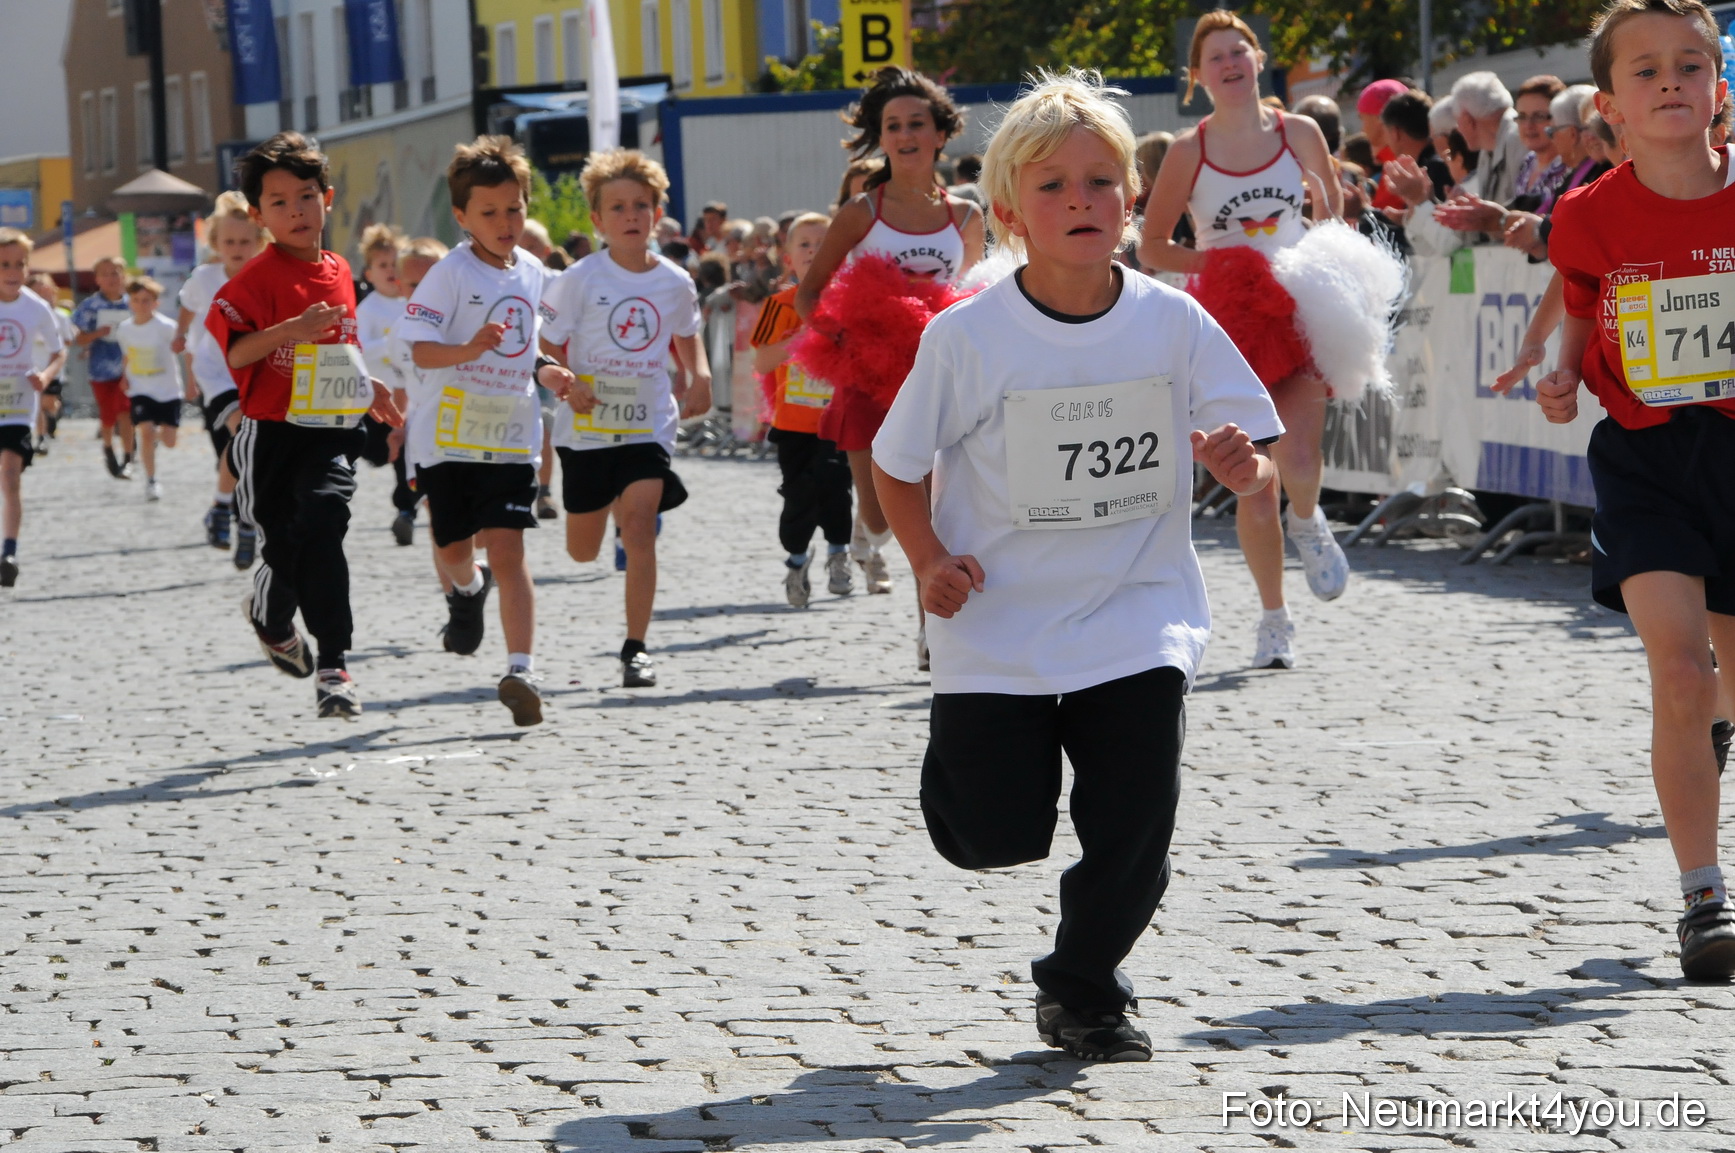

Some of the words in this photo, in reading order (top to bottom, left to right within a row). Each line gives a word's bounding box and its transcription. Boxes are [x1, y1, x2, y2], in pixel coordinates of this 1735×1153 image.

[861, 13, 893, 62] B
[1691, 249, 1709, 260] 11.
[1661, 289, 1720, 312] Jonas
[1627, 330, 1645, 348] K4
[320, 351, 350, 366] Jonas
[319, 376, 368, 399] 7005
[597, 381, 637, 395] Thomas
[1643, 388, 1682, 400] BOCK
[599, 403, 647, 421] 7103
[1051, 398, 1113, 421] CHRIS
[466, 419, 524, 443] 7102
[1058, 432, 1159, 481] 7322
[1109, 492, 1158, 509] PFLEIDERER
[1029, 507, 1069, 516] BOCK
